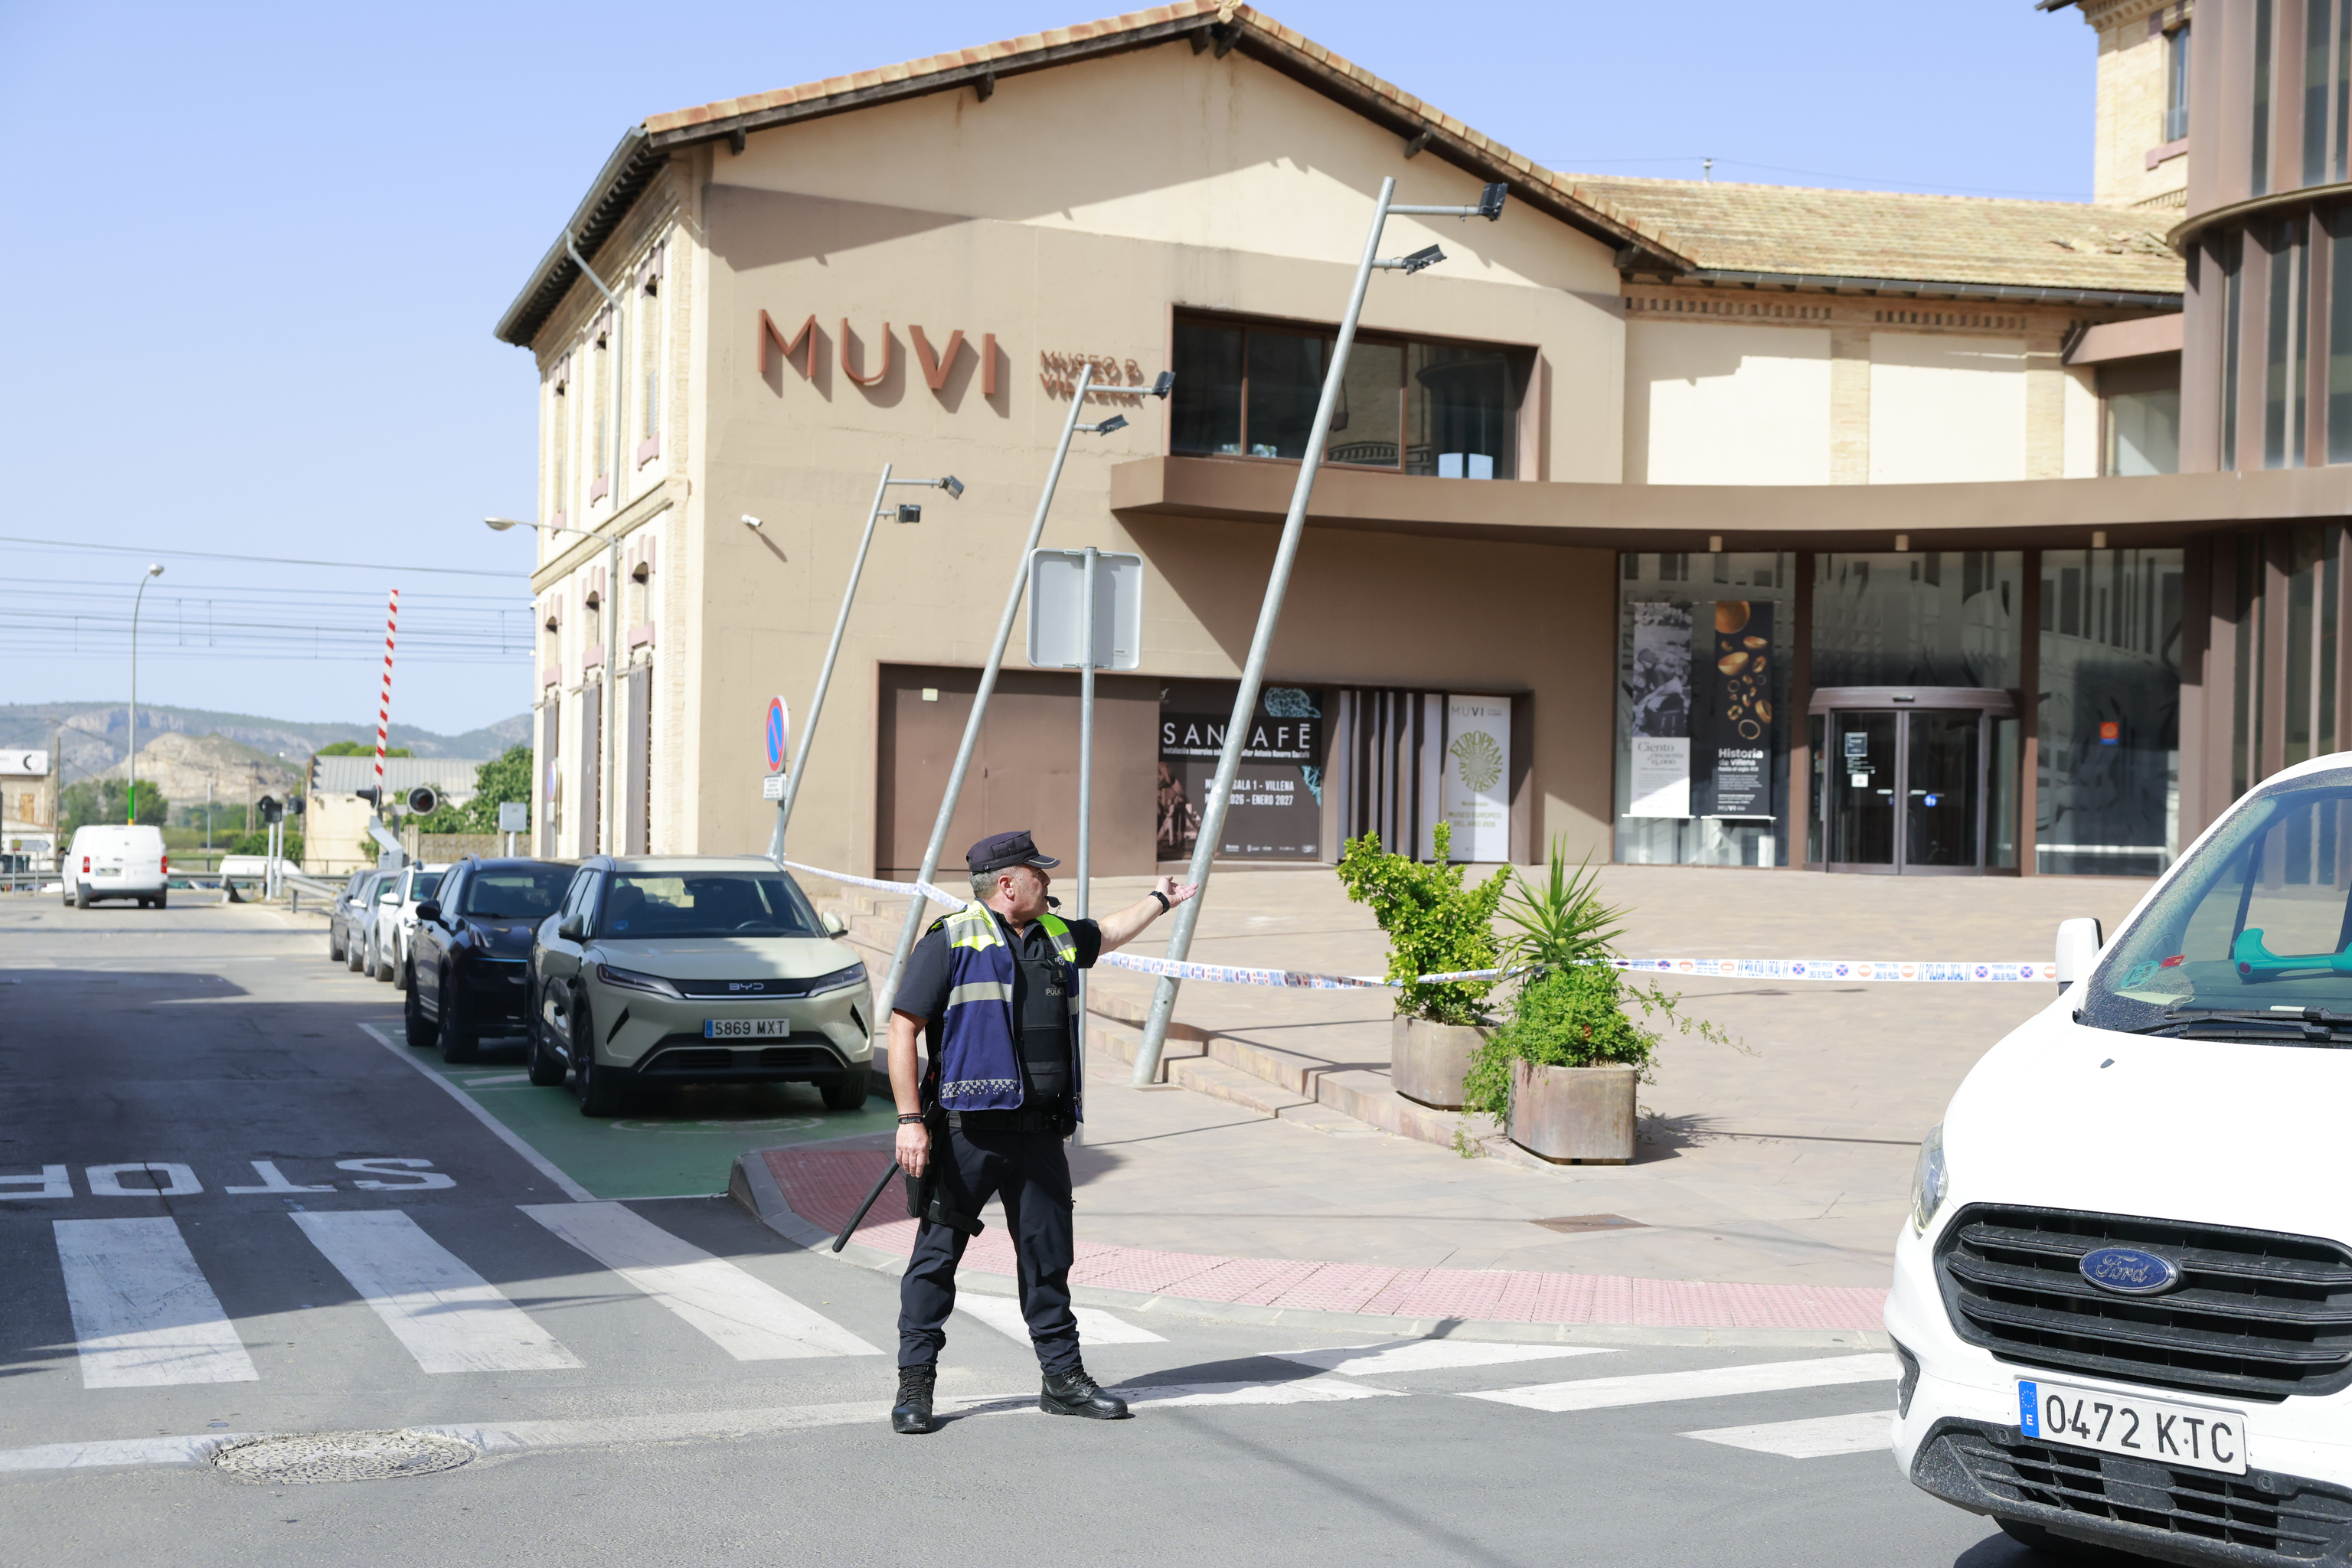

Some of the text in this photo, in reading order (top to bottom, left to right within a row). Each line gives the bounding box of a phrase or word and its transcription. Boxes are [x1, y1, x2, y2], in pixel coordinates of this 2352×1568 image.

[758, 309, 996, 394] MUVI
[1040, 349, 1116, 375] MUSEO
[1638, 741, 1674, 752] Ciento
[1718, 748, 1763, 759] Historia
[1233, 779, 1251, 791] SALA
[1265, 780, 1295, 792] VILLENA
[1229, 794, 1245, 805] 026
[1252, 794, 1274, 805] ENERO
[1275, 795, 1294, 806] 2027
[1926, 964, 1946, 981] POLICIA
[1947, 964, 1964, 981] LOCAL
[715, 1021, 750, 1035] 5869
[757, 1021, 784, 1034] MXT
[2096, 1253, 2150, 1283] Ford
[2026, 1394, 2234, 1463] E 0472 KTC
